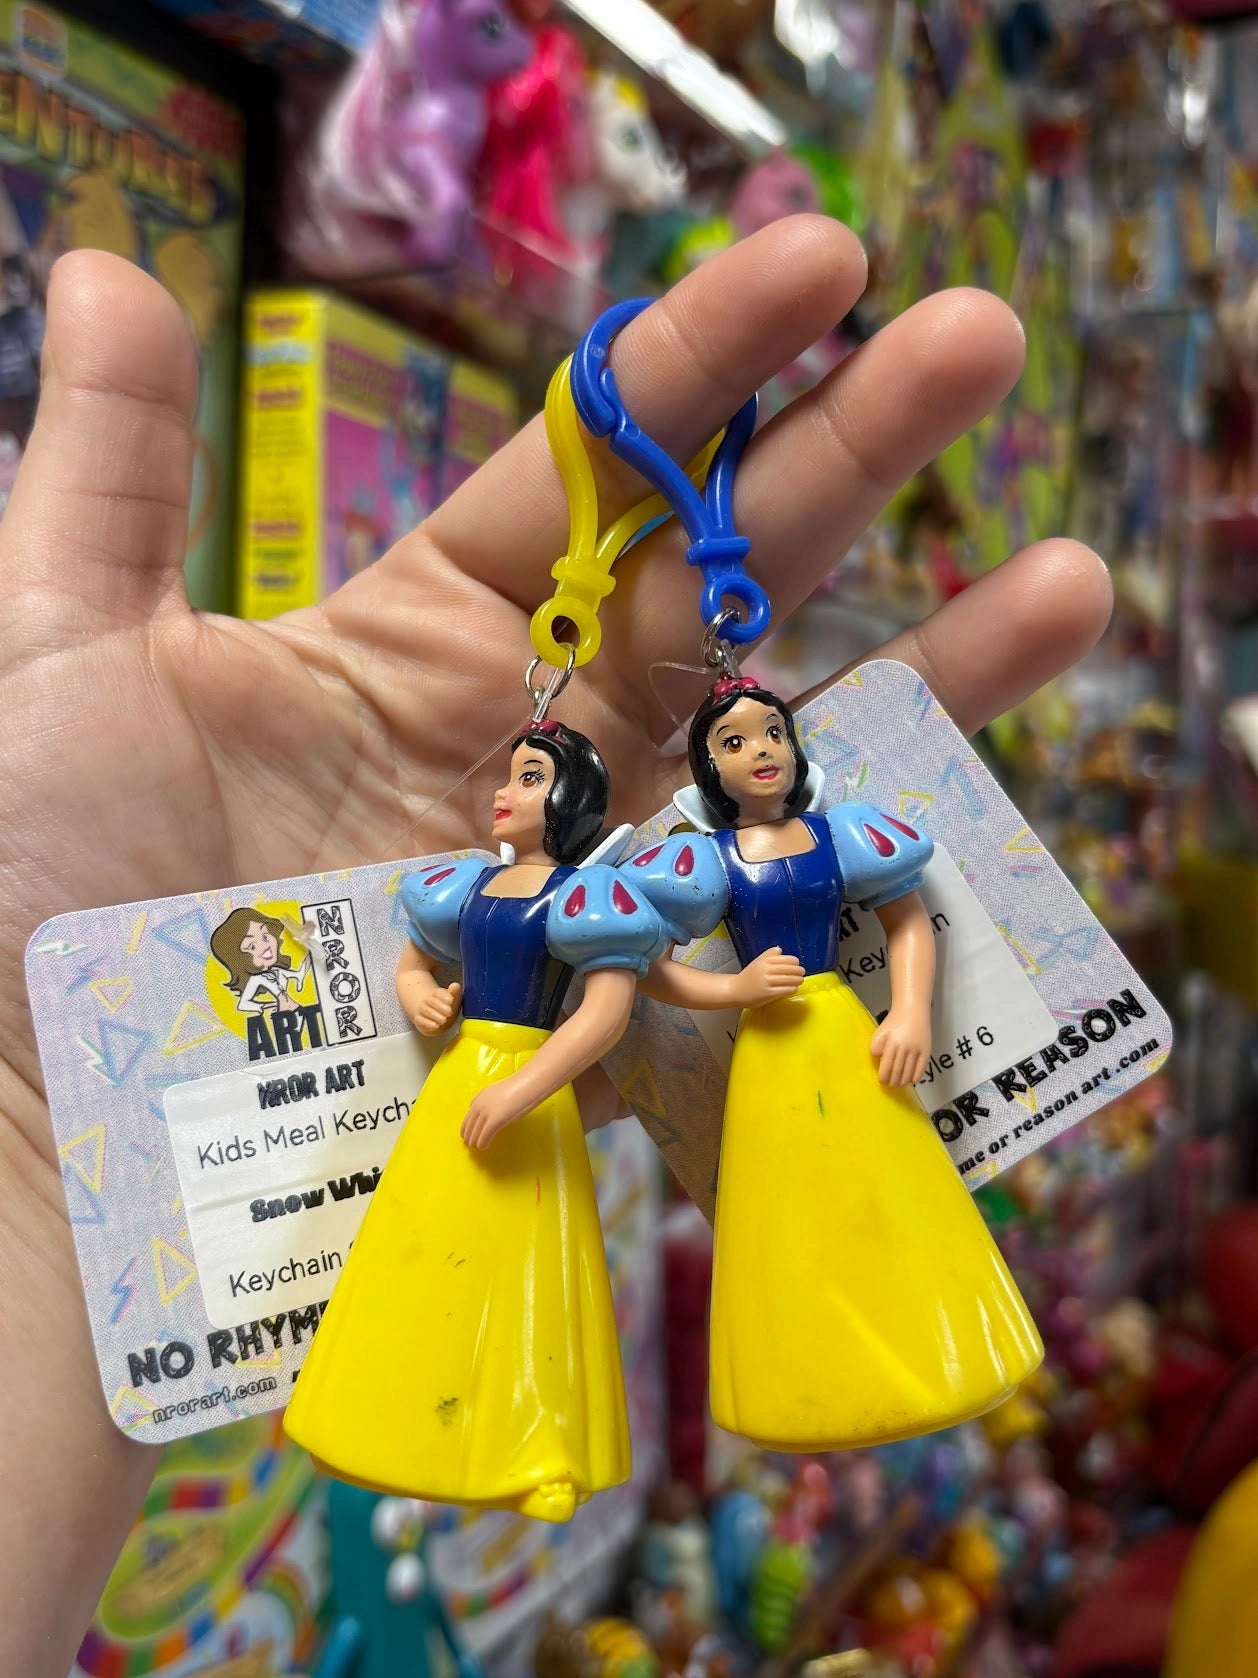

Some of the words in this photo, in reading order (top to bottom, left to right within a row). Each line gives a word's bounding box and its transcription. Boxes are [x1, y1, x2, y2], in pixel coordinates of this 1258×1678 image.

[317, 906, 363, 1039] NROR
[247, 1004, 323, 1062] ART
[976, 1026, 994, 1046] 6
[325, 1059, 366, 1095] ART
[930, 1090, 990, 1143] OR
[991, 988, 1147, 1102] REASON
[197, 1135, 257, 1170] Kids
[263, 1115, 326, 1153] Meal
[333, 1096, 416, 1136] Keych
[988, 1134, 1009, 1154] or
[1012, 1088, 1079, 1140] reason
[1081, 1066, 1111, 1095] art
[250, 1187, 325, 1223] Snow
[327, 1166, 385, 1202] Whi
[229, 1250, 343, 1298] Keychain
[127, 1340, 195, 1388] NO
[206, 1299, 330, 1369] RHYM
[152, 1375, 278, 1424] nrorart.com
